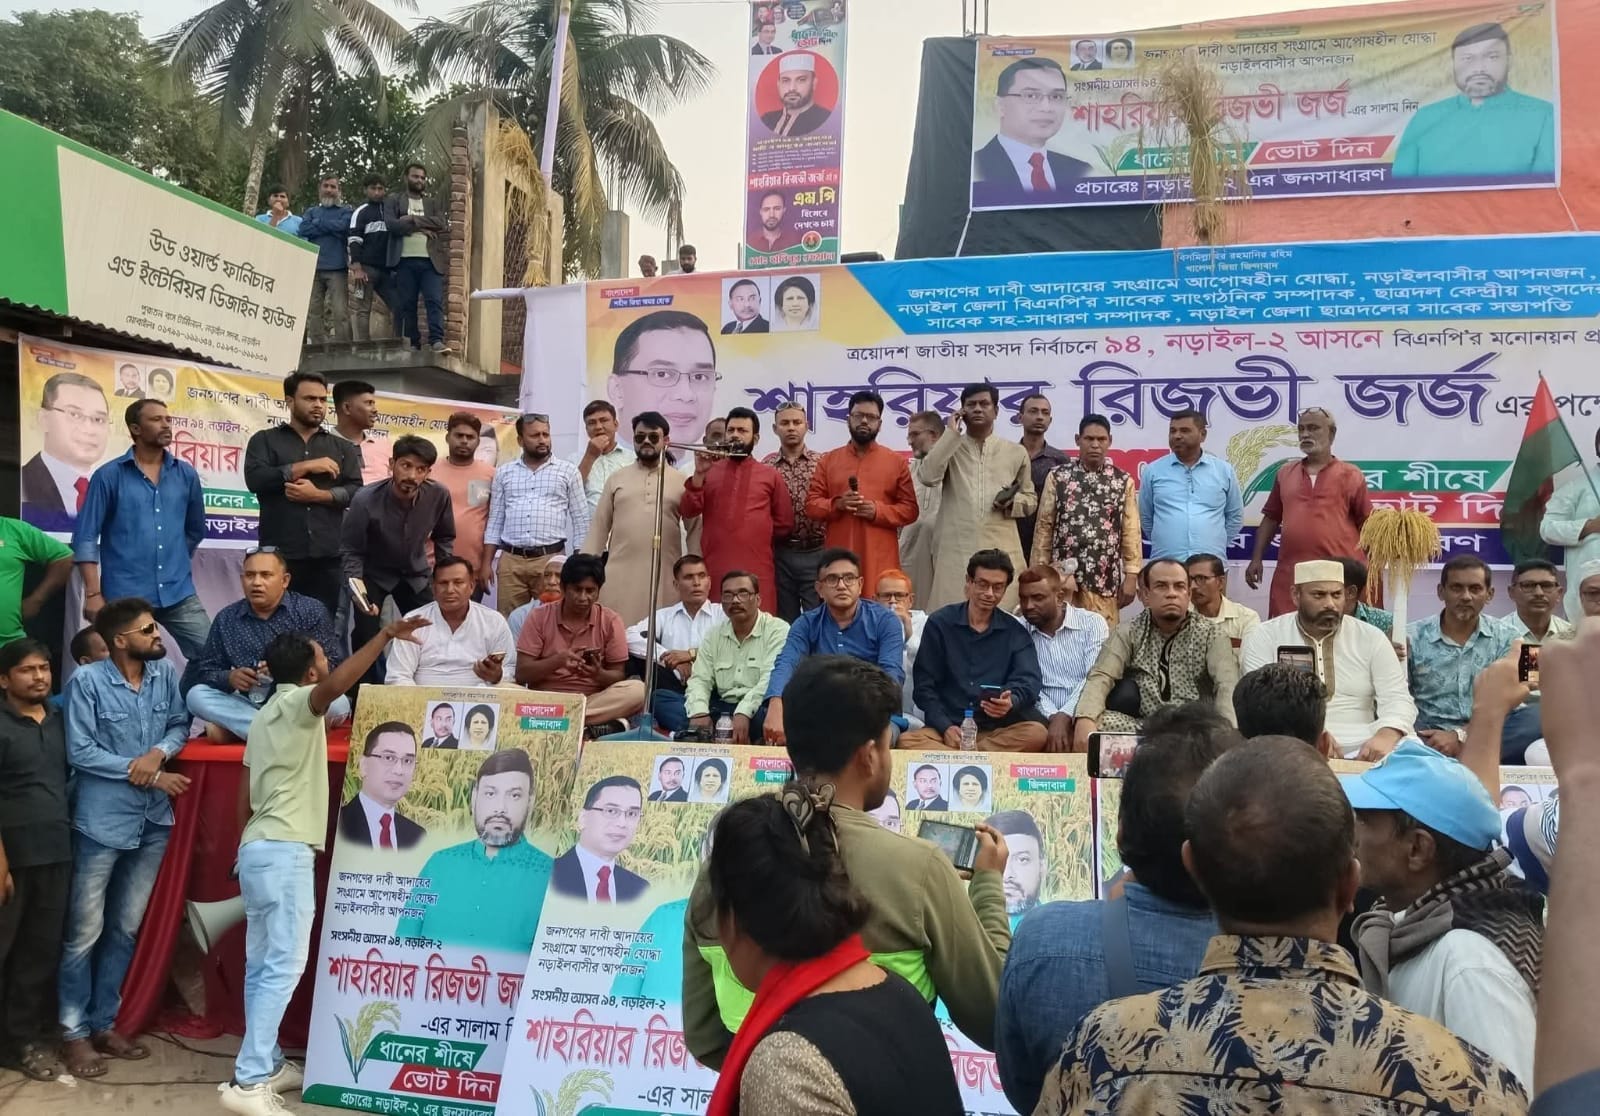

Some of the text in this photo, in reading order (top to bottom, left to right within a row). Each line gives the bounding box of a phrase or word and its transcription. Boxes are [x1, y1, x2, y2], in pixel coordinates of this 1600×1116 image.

[1198, 42, 1223, 57] দাবী
[1227, 41, 1278, 57] আদায়ের
[1283, 36, 1326, 52] সংগ্রামে
[1331, 32, 1397, 50] আপোষহীন
[1402, 32, 1437, 46] যোদ্ধা
[1220, 54, 1356, 74] নড়াইলবাসীর আপনজন
[1074, 77, 1110, 93] সংসদীয়
[1294, 78, 1351, 119] জর্জ
[1371, 102, 1399, 114] সালাম
[1401, 98, 1419, 113] নিন
[1265, 140, 1321, 162] ভোট
[1331, 137, 1376, 159] দিন
[1074, 180, 1139, 197] প্রচারেঃ
[1249, 174, 1277, 189] এর
[1282, 167, 1387, 187] জনসাধারণ
[150, 229, 275, 294] উড ওয়ার্ল্ড ফার্নিচার
[907, 286, 980, 300] জনগণের
[986, 280, 1025, 297] দাবী
[1029, 280, 1106, 295] আদায়ের
[1112, 278, 1180, 292] সংগ্রামে
[1185, 271, 1288, 289] আপোষহীন
[1362, 265, 1488, 286] নড়াইলবাসীর
[140, 260, 207, 302] ইন্টেরিয়র
[210, 283, 260, 320] ডিজাইন
[262, 306, 297, 332] হাউজ
[897, 301, 956, 318] নড়াইল
[963, 300, 1007, 313] জেলা
[1104, 293, 1166, 308] সাবেক
[1173, 287, 1268, 305] সাংগঠনিক
[1373, 285, 1443, 300] ছাত্রদল
[1450, 280, 1520, 299] কেন্দ্রীয়
[926, 315, 983, 329] সাবেক
[989, 312, 1089, 328] সহ-সাধারণ
[1189, 305, 1256, 322] নড়াইল
[1263, 305, 1312, 319] জেলা
[1319, 303, 1411, 319] ছাত্রদলের
[1417, 301, 1482, 315] সাবেক
[1489, 297, 1574, 313] সভাপতি
[847, 346, 909, 361] ত্রয়োদশ
[916, 340, 969, 359] জাতীয়
[974, 342, 1024, 356] সংসদ
[1028, 335, 1099, 356] নির্বাচনে
[1164, 327, 1289, 356] নড়াইল-২
[1296, 328, 1384, 350] আসনে
[1489, 330, 1578, 345] মনোনয়ন
[186, 386, 241, 405] জনগণের
[245, 392, 271, 409] দাবী
[1070, 355, 1318, 428] রিজভী
[1333, 351, 1501, 426] জর্জ
[1398, 461, 1490, 490] শীষে
[1455, 492, 1504, 520] দি
[520, 705, 557, 716] বাংলাদেশ
[528, 718, 562, 729] জিন্দাবাদ
[1017, 765, 1058, 777] বাংলাদেশ
[1027, 778, 1067, 791] জিন্দাবাদ
[339, 871, 431, 889] জনগণের দাবী আদায়ের
[336, 886, 366, 900] সংগ্রামে
[368, 888, 412, 903] আপোষহীন
[334, 900, 425, 920] নড়াইলবাসীর আপনজন
[331, 927, 361, 943] সংসদীয়
[363, 932, 387, 945] আসন
[404, 934, 443, 950] নড়াইল-২
[546, 925, 654, 944] জনগণের দাবী আদায়ের
[541, 941, 662, 961] সংগ্রামে আপোষহীন যোদ্ধা
[328, 947, 491, 1007] শাহরিয়ার রিজভী
[538, 957, 646, 977] নড়াইলবাসীর আপনজন
[531, 986, 569, 1005] সংসদীয়
[570, 991, 600, 1006] আসন
[621, 994, 666, 1011] নড়াইল-২
[456, 1018, 501, 1041] সালাম
[526, 1008, 638, 1067] শাহরিয়ার
[379, 1039, 476, 1071] ধানের শীষে
[403, 1069, 496, 1099] ভোট দিন
[340, 1091, 373, 1108] প্রচারেঃ
[375, 1096, 420, 1116] নড়াইল-২
